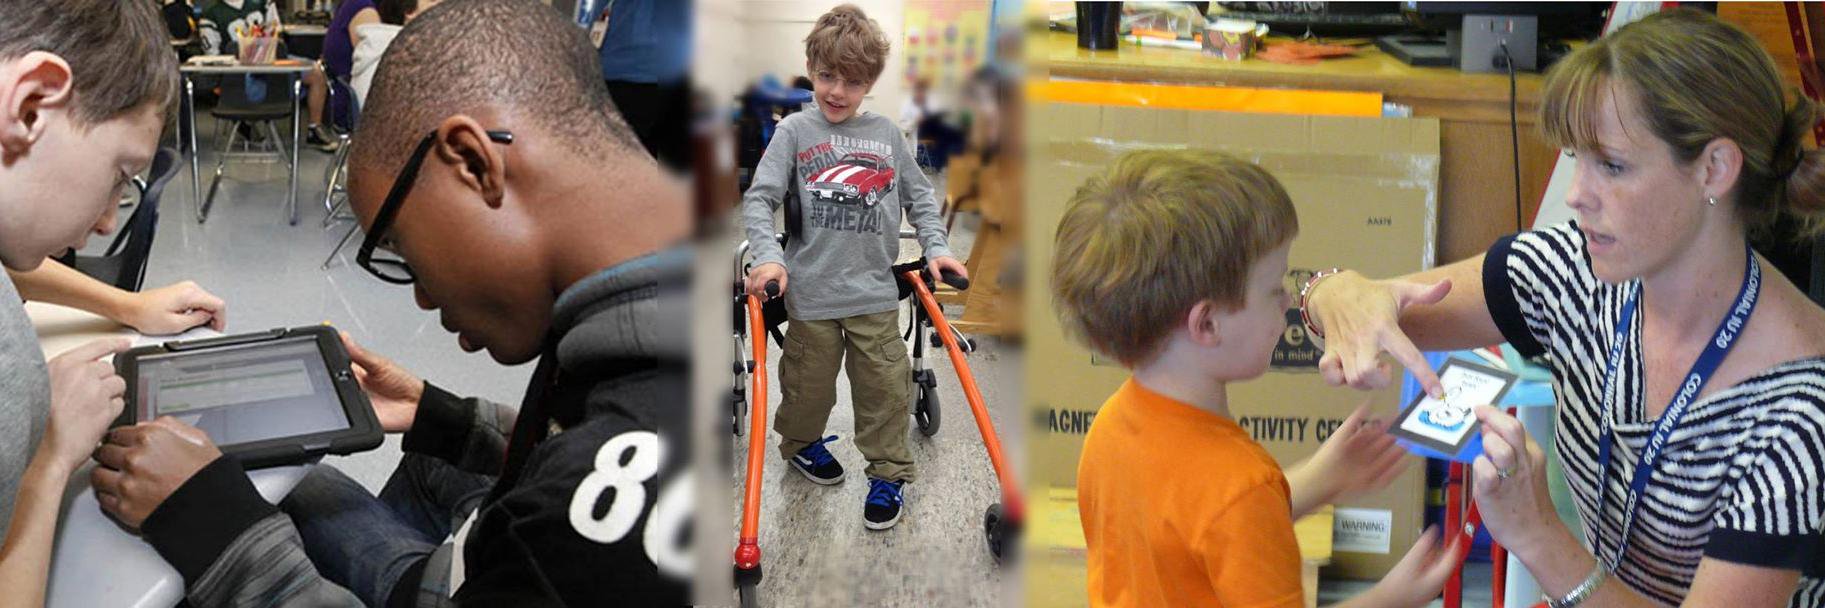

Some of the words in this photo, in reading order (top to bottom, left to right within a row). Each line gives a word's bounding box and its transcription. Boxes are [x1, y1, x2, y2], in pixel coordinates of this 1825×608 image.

[799, 146, 815, 162] PUT
[815, 142, 833, 154] THE
[799, 151, 838, 178] PEDAL
[825, 205, 882, 235] METAL
[1735, 254, 1760, 315] COLONIAL
[1726, 315, 1742, 333] IU
[1715, 328, 1733, 349] 20
[1274, 348, 1284, 360] in
[1288, 348, 1314, 361] mind
[1601, 369, 1617, 435] COLONIAL
[1614, 331, 1623, 350] 20
[1659, 372, 1701, 433] COLONIAL
[1651, 431, 1664, 449] IU
[1643, 445, 1656, 465] 20
[1341, 519, 1384, 532] WARNING
